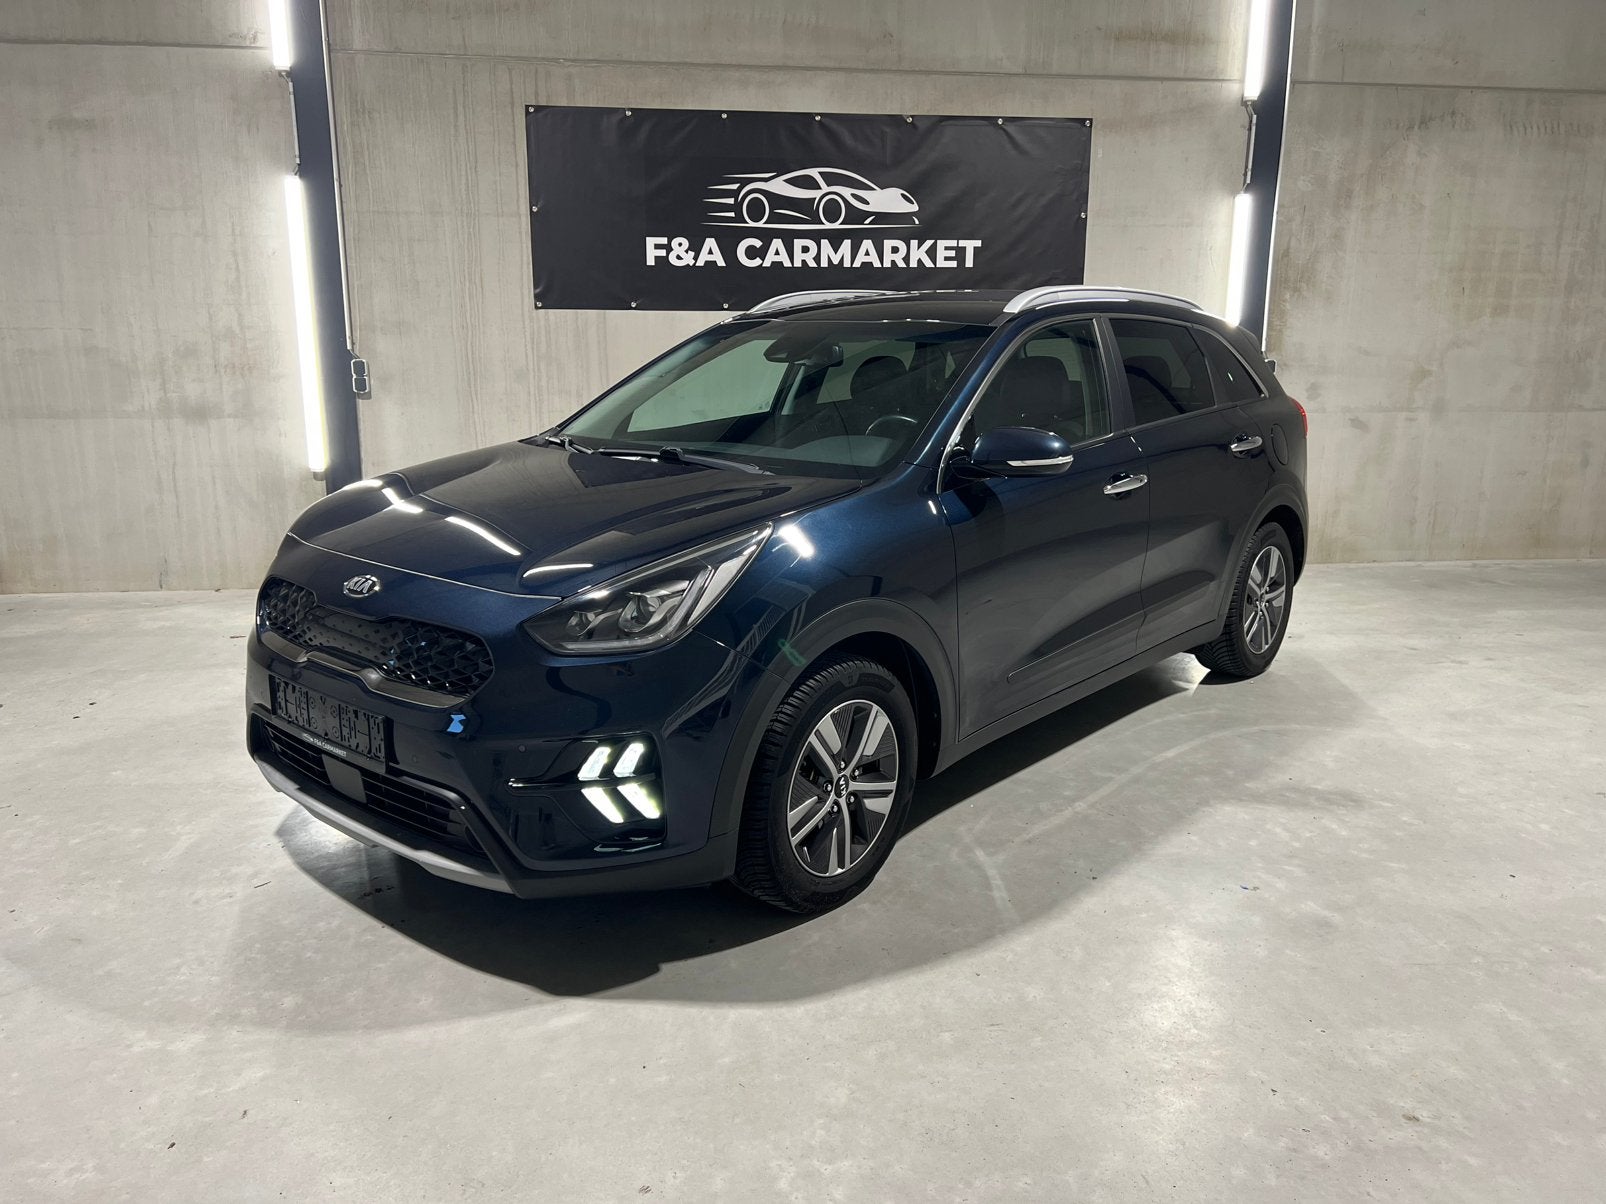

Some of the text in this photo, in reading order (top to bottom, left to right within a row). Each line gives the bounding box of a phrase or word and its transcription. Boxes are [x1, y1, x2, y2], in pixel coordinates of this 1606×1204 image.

[645, 236, 982, 268] F&A CARMARKET
[346, 577, 373, 594] KIA
